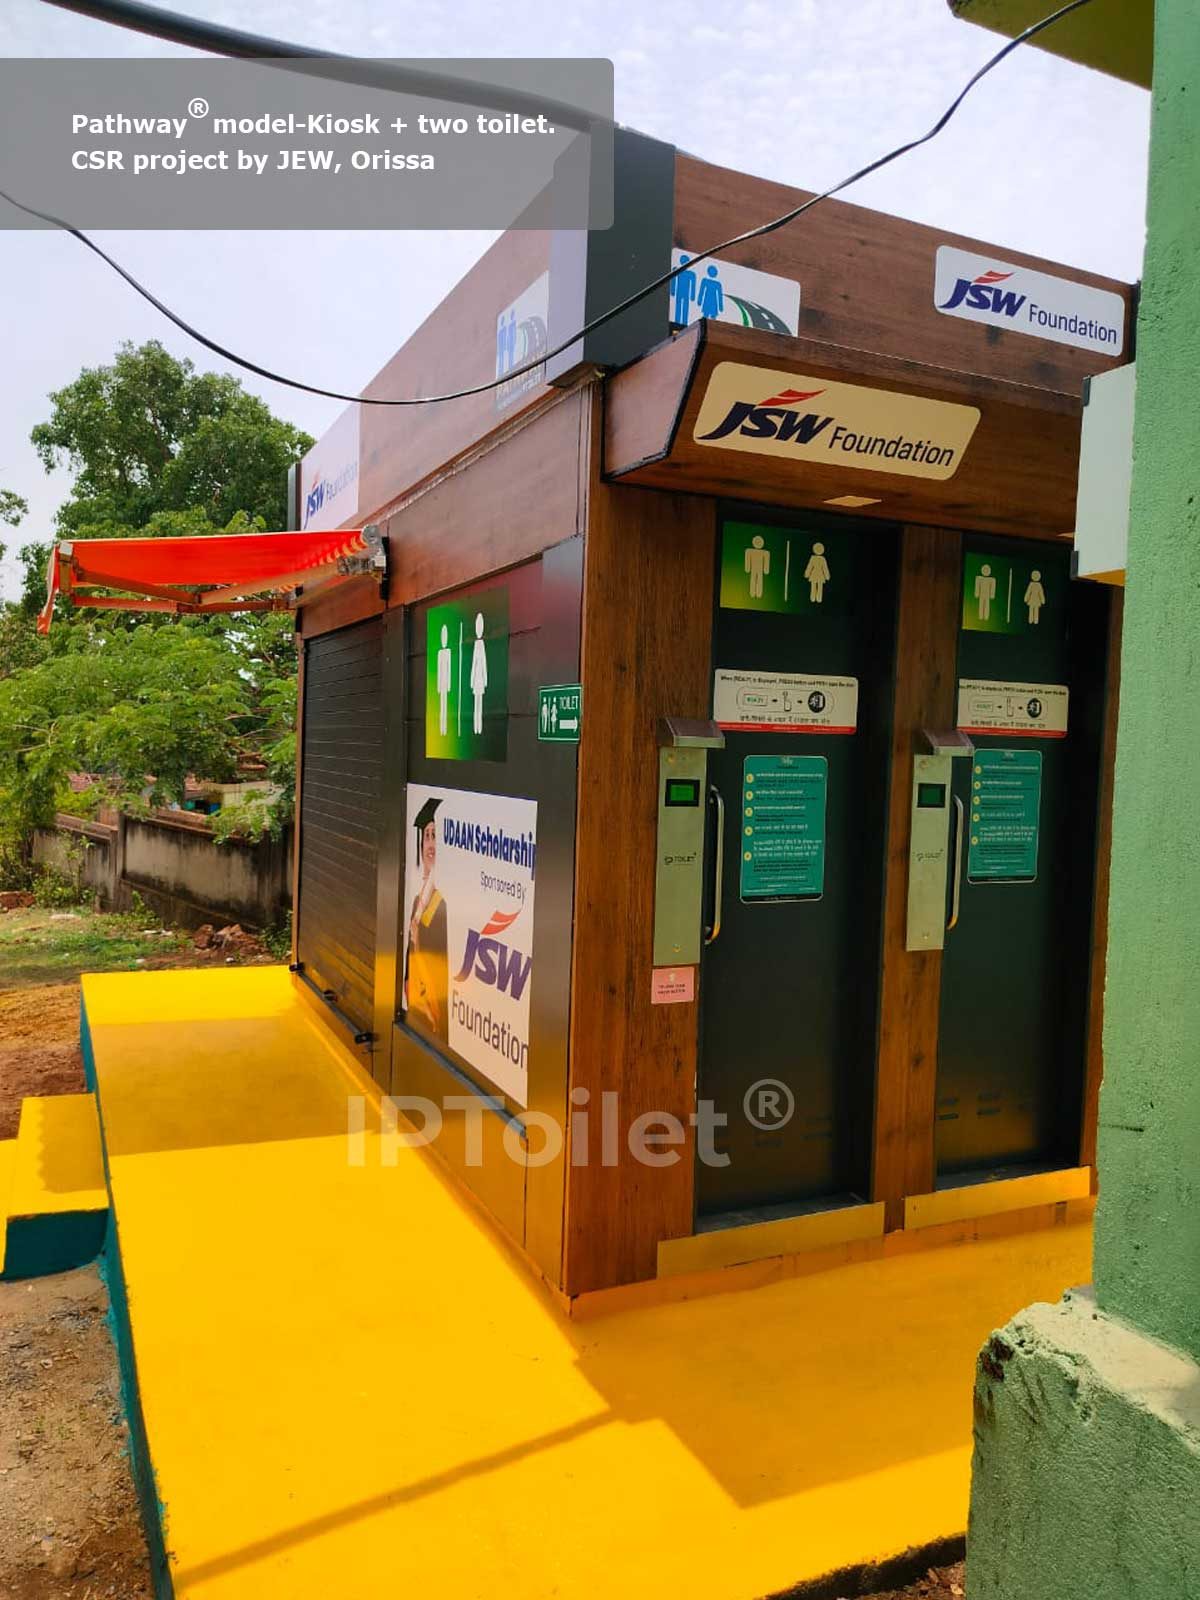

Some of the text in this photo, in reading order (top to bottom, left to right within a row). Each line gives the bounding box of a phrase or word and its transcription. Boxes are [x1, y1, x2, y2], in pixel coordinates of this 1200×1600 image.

[938, 278, 1117, 345] JSW Foundation
[697, 401, 954, 467] JSW Foundation
[443, 817, 474, 852] UDAAN
[480, 871, 527, 906] Sponsored By
[454, 928, 533, 1001] JSW
